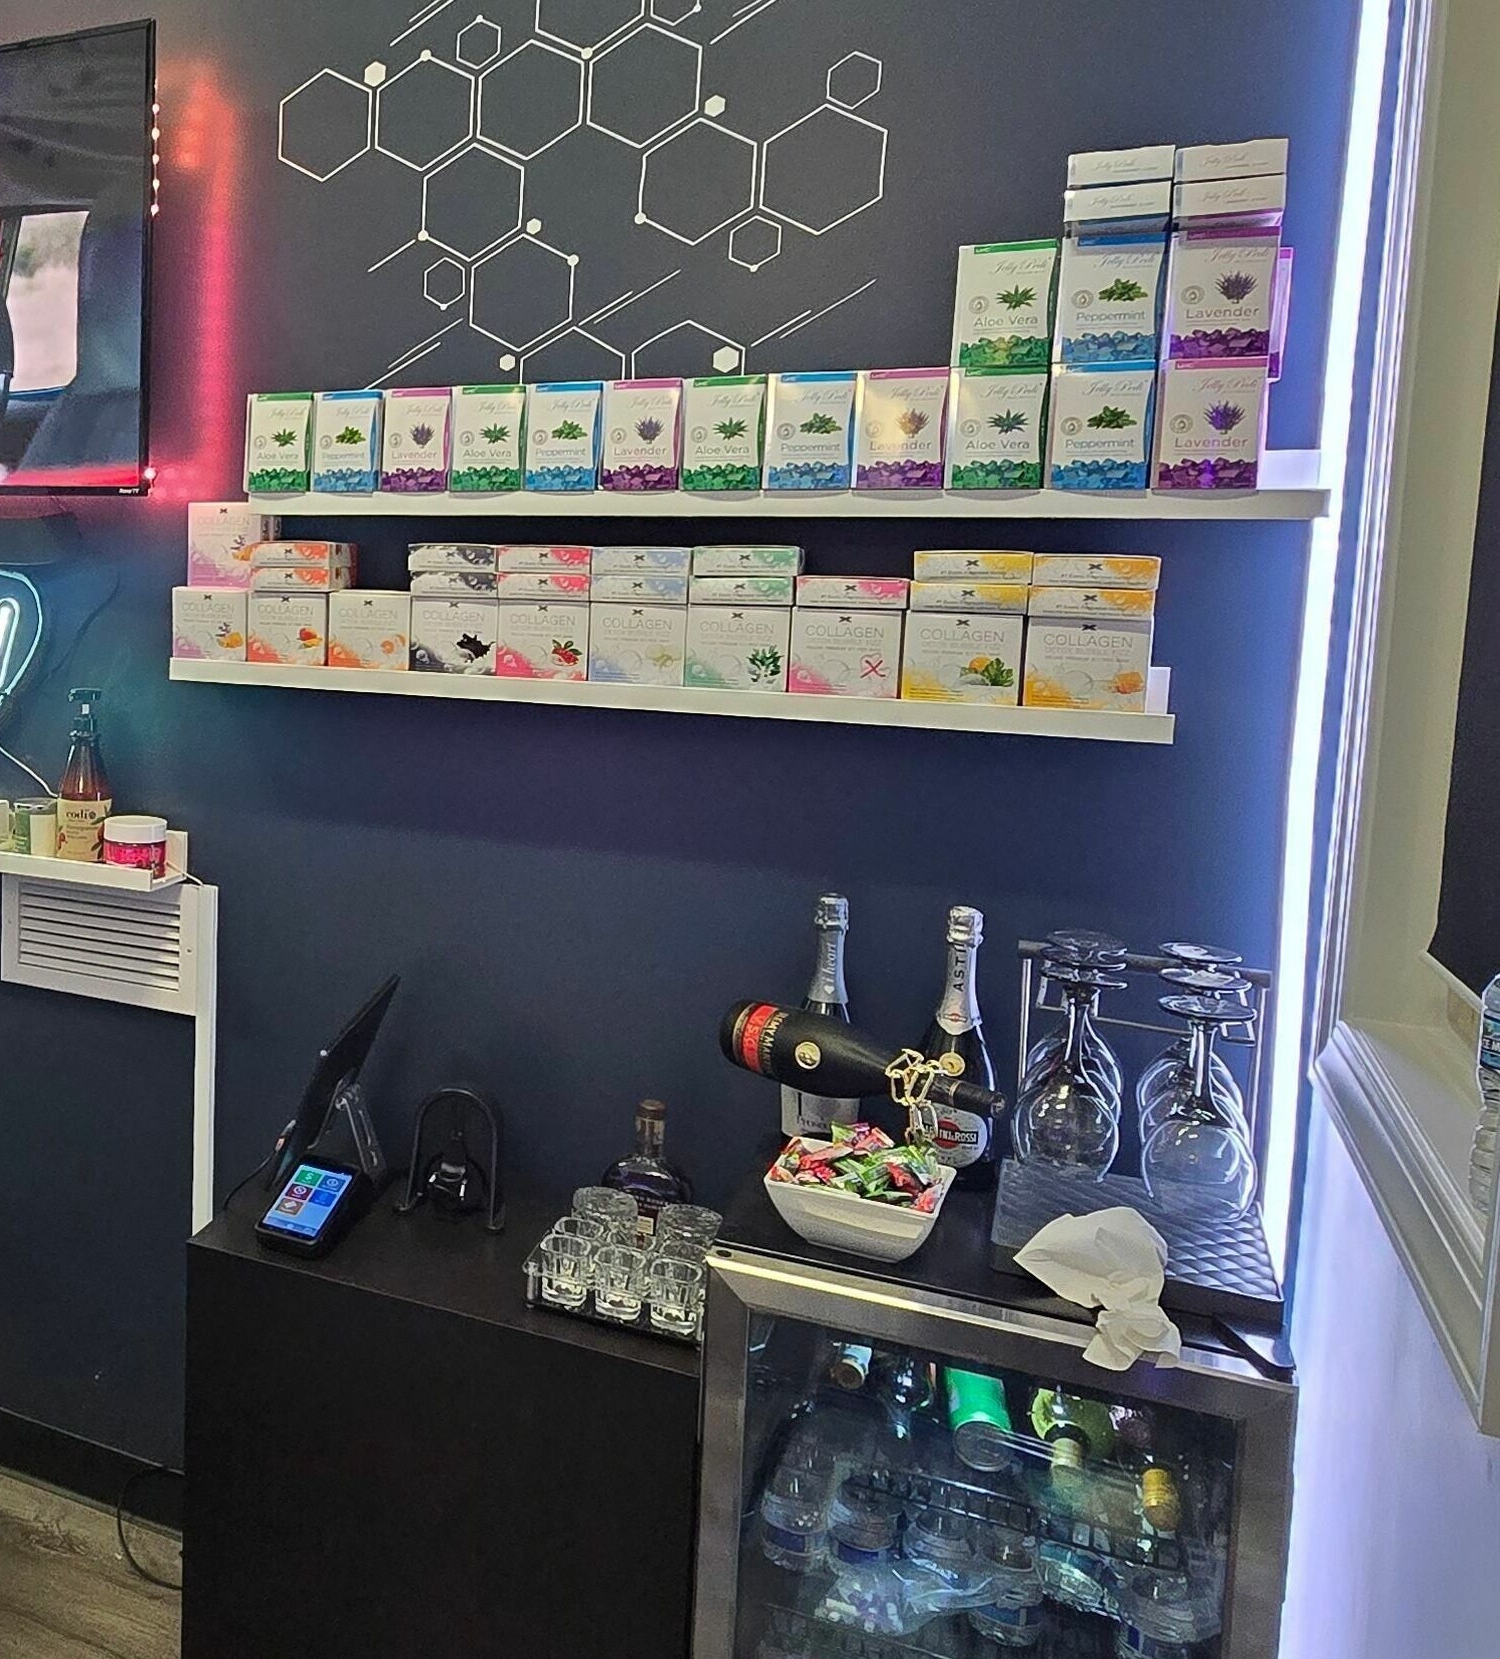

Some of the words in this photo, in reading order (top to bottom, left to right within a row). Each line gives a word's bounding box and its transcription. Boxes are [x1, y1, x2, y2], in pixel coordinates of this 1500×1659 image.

[1076, 311, 1146, 322] Peppermint
[1186, 306, 1259, 319] Lavender
[973, 317, 1004, 327] Aloe
[1008, 315, 1038, 325] Vera
[781, 443, 841, 453] Peppermint
[965, 440, 996, 450] Aloe
[1000, 439, 1030, 450] Vera
[1065, 439, 1135, 451] Peppermint
[1174, 437, 1248, 448] Lavender
[256, 451, 277, 460] Aloe
[279, 451, 299, 460] Vera
[391, 450, 438, 460] Lavender
[463, 449, 486, 458] Aloe
[489, 448, 512, 457] Vera
[535, 447, 586, 458] Peppermint
[613, 446, 667, 456] Lavender
[694, 446, 721, 456] Aloe
[724, 445, 750, 454] Vera
[257, 604, 314, 616] COLLAGEN
[338, 608, 398, 619] COLLAGEN
[423, 609, 485, 622] COLLAGEN
[509, 613, 576, 627] COLLAGEN
[602, 616, 673, 632] COLLAGEN
[700, 620, 774, 636] COLLAGEN
[804, 624, 885, 639] COLLAGEN
[920, 628, 1005, 643] COLLAGEN
[1043, 633, 1134, 649] COLLAGEN
